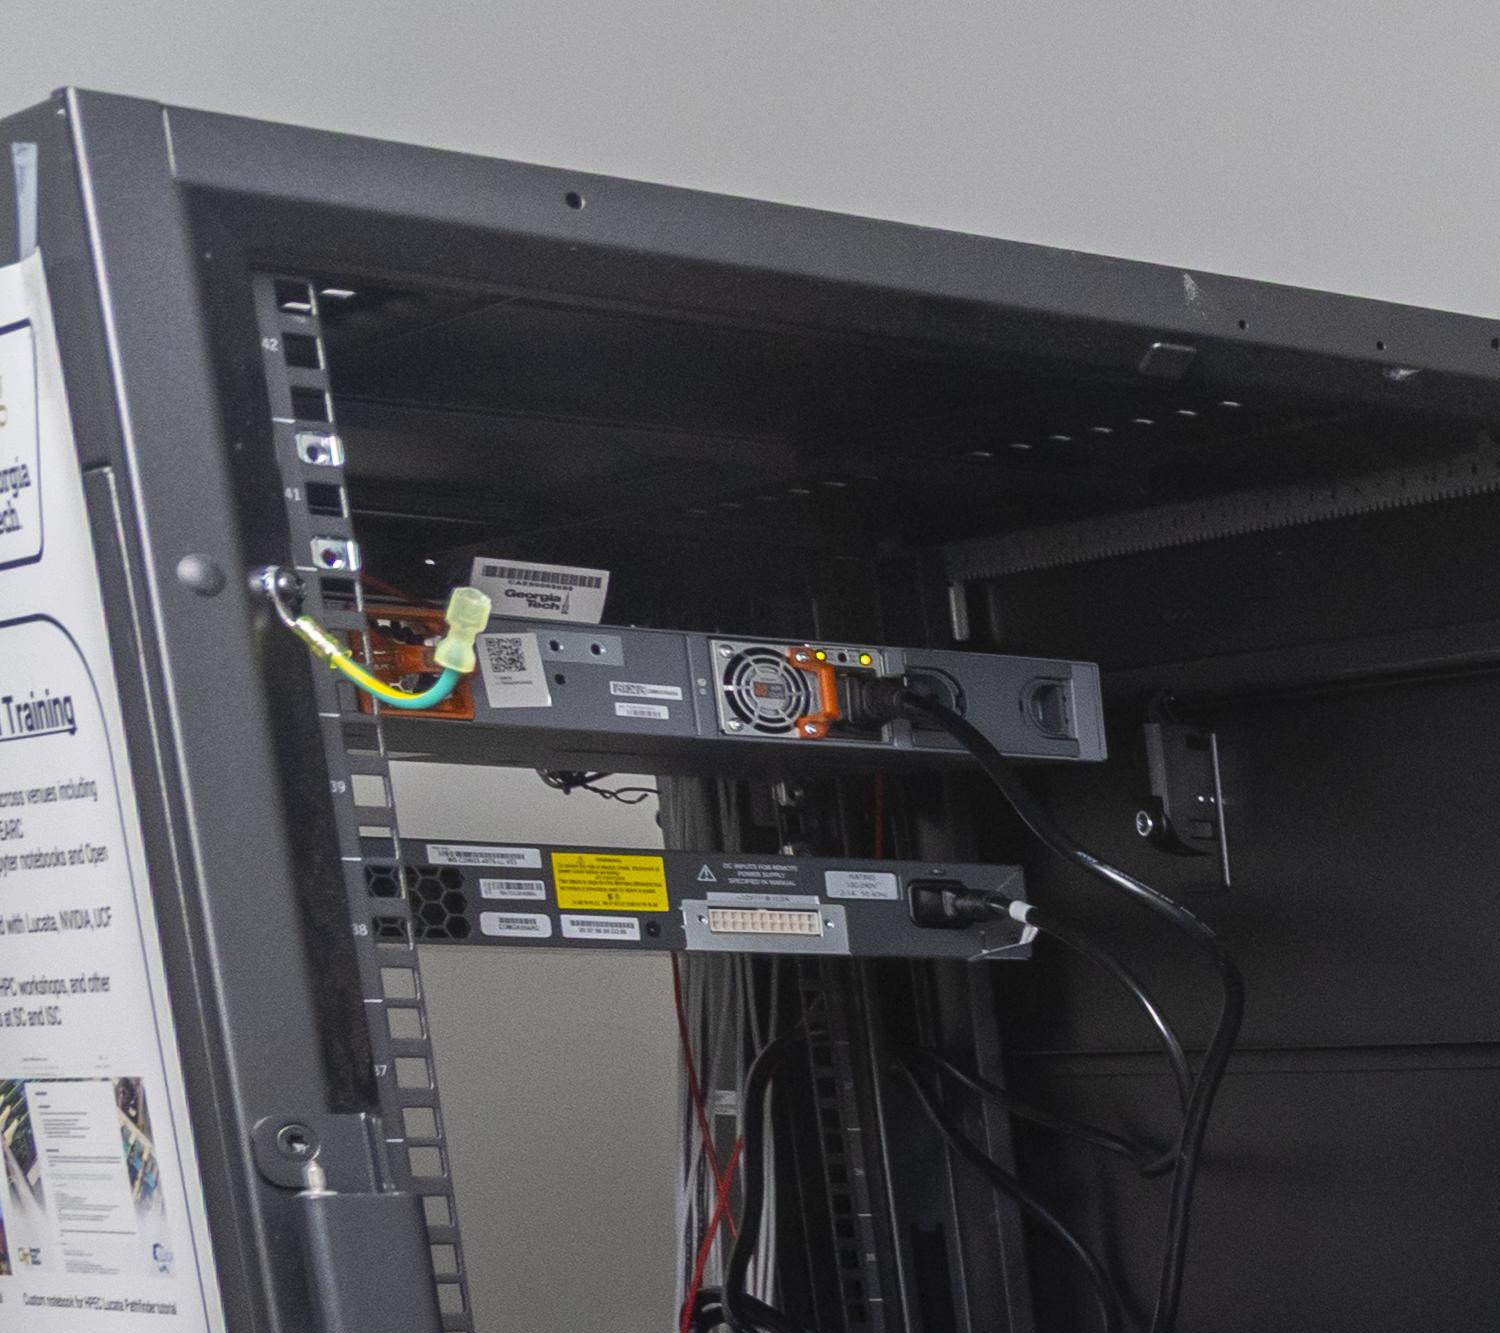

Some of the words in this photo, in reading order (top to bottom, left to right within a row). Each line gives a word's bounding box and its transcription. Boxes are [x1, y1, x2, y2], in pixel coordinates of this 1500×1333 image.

[261, 338, 278, 351] 42
[285, 487, 300, 501] 41
[504, 588, 561, 603] Georgia
[526, 599, 560, 611] Tech
[2, 689, 76, 735] Training
[0, 790, 25, 807] cross
[28, 786, 57, 804] venues
[59, 776, 98, 802] including
[331, 780, 345, 793] 39
[0, 818, 23, 840] EARC
[20, 846, 67, 869] notebooks
[68, 843, 85, 865] and
[354, 923, 368, 936] 38
[70, 971, 87, 994] and
[87, 971, 110, 994] other
[27, 1006, 45, 1027] and
